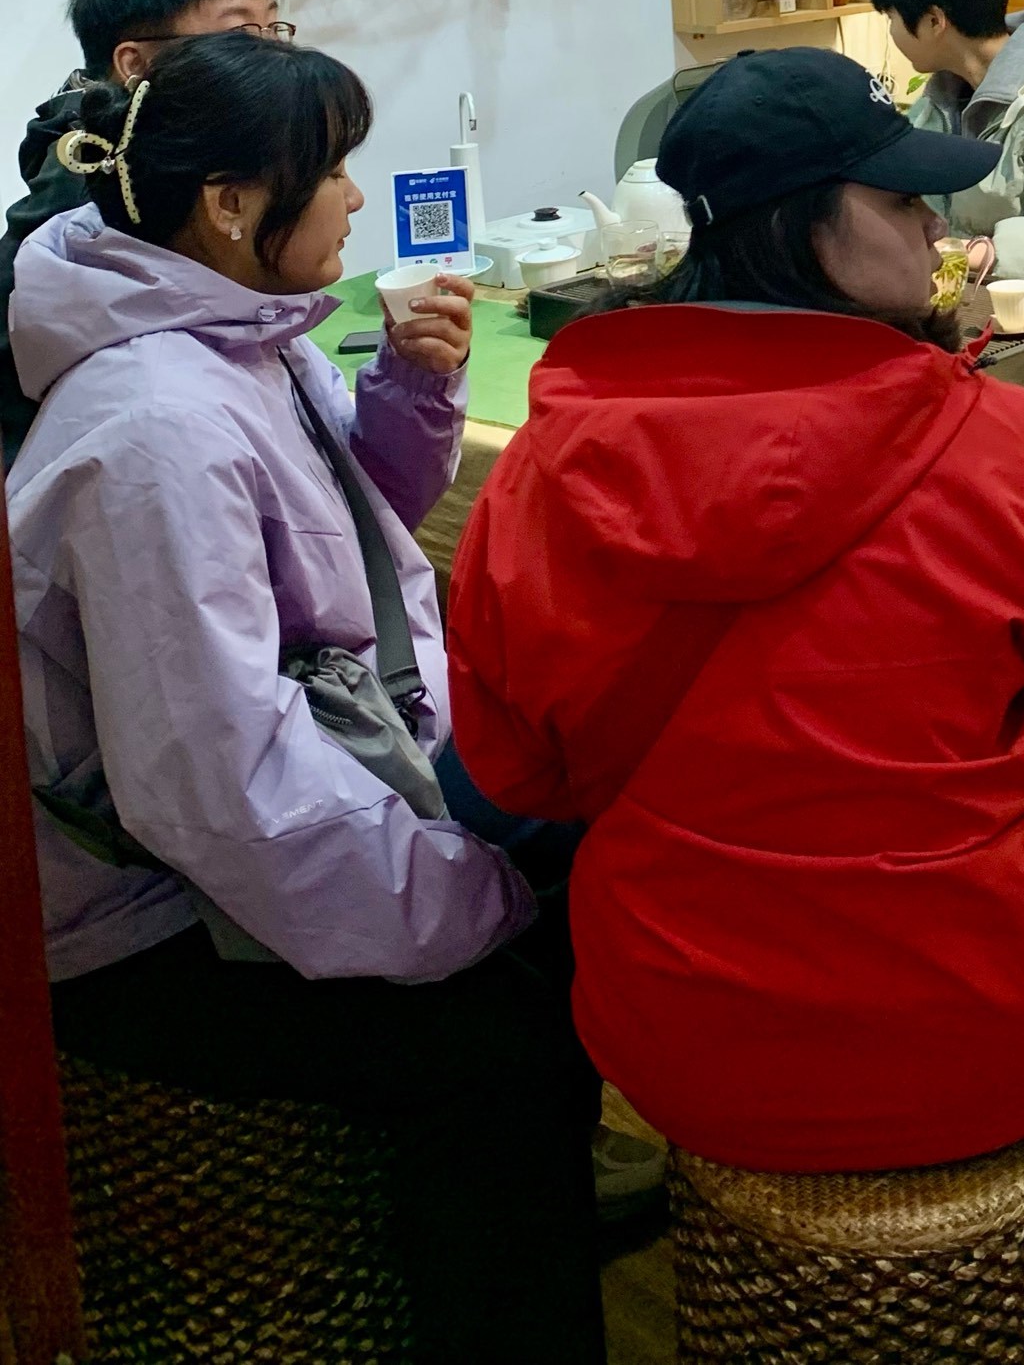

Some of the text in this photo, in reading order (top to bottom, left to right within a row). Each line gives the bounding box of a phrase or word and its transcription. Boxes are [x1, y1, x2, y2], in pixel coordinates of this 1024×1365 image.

[404, 190, 457, 202] 推荐使用支付宝
